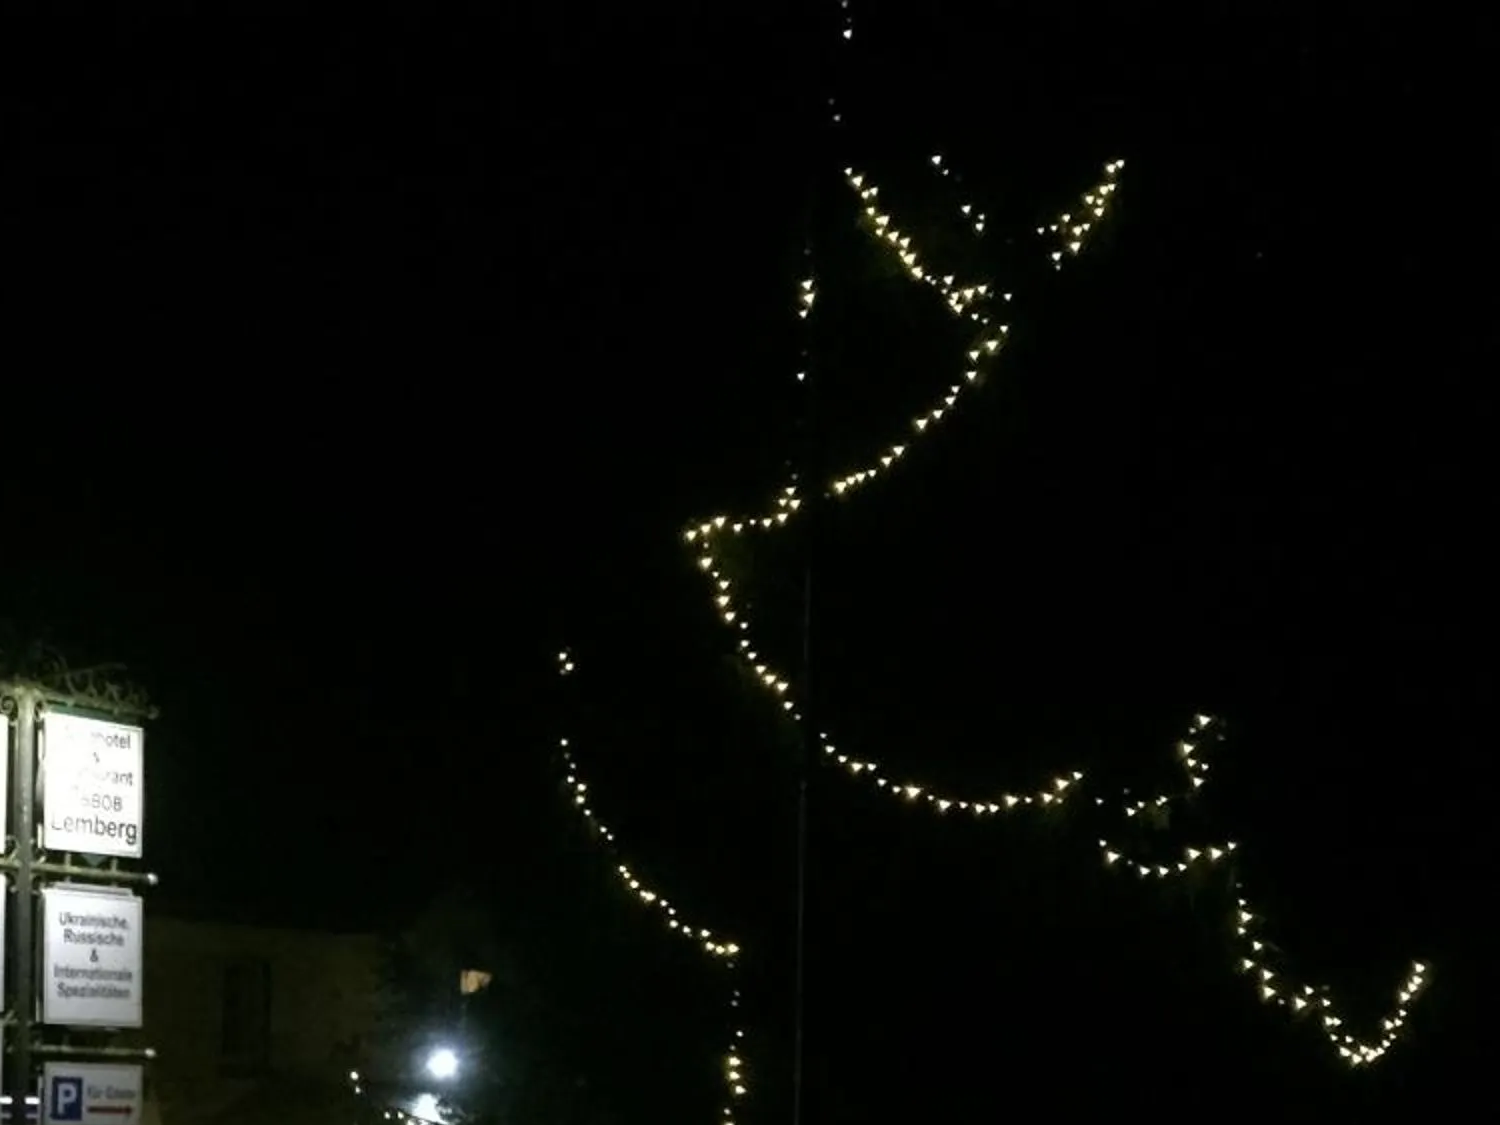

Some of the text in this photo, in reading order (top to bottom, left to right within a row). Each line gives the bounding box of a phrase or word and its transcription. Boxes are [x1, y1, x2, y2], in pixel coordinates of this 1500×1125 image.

[51, 814, 138, 846] Lemberg
[63, 929, 124, 947] Russische
[89, 948, 99, 963] &
[54, 964, 132, 982] Internationale
[56, 981, 131, 999] Spezialitäten
[57, 1083, 77, 1115] P
